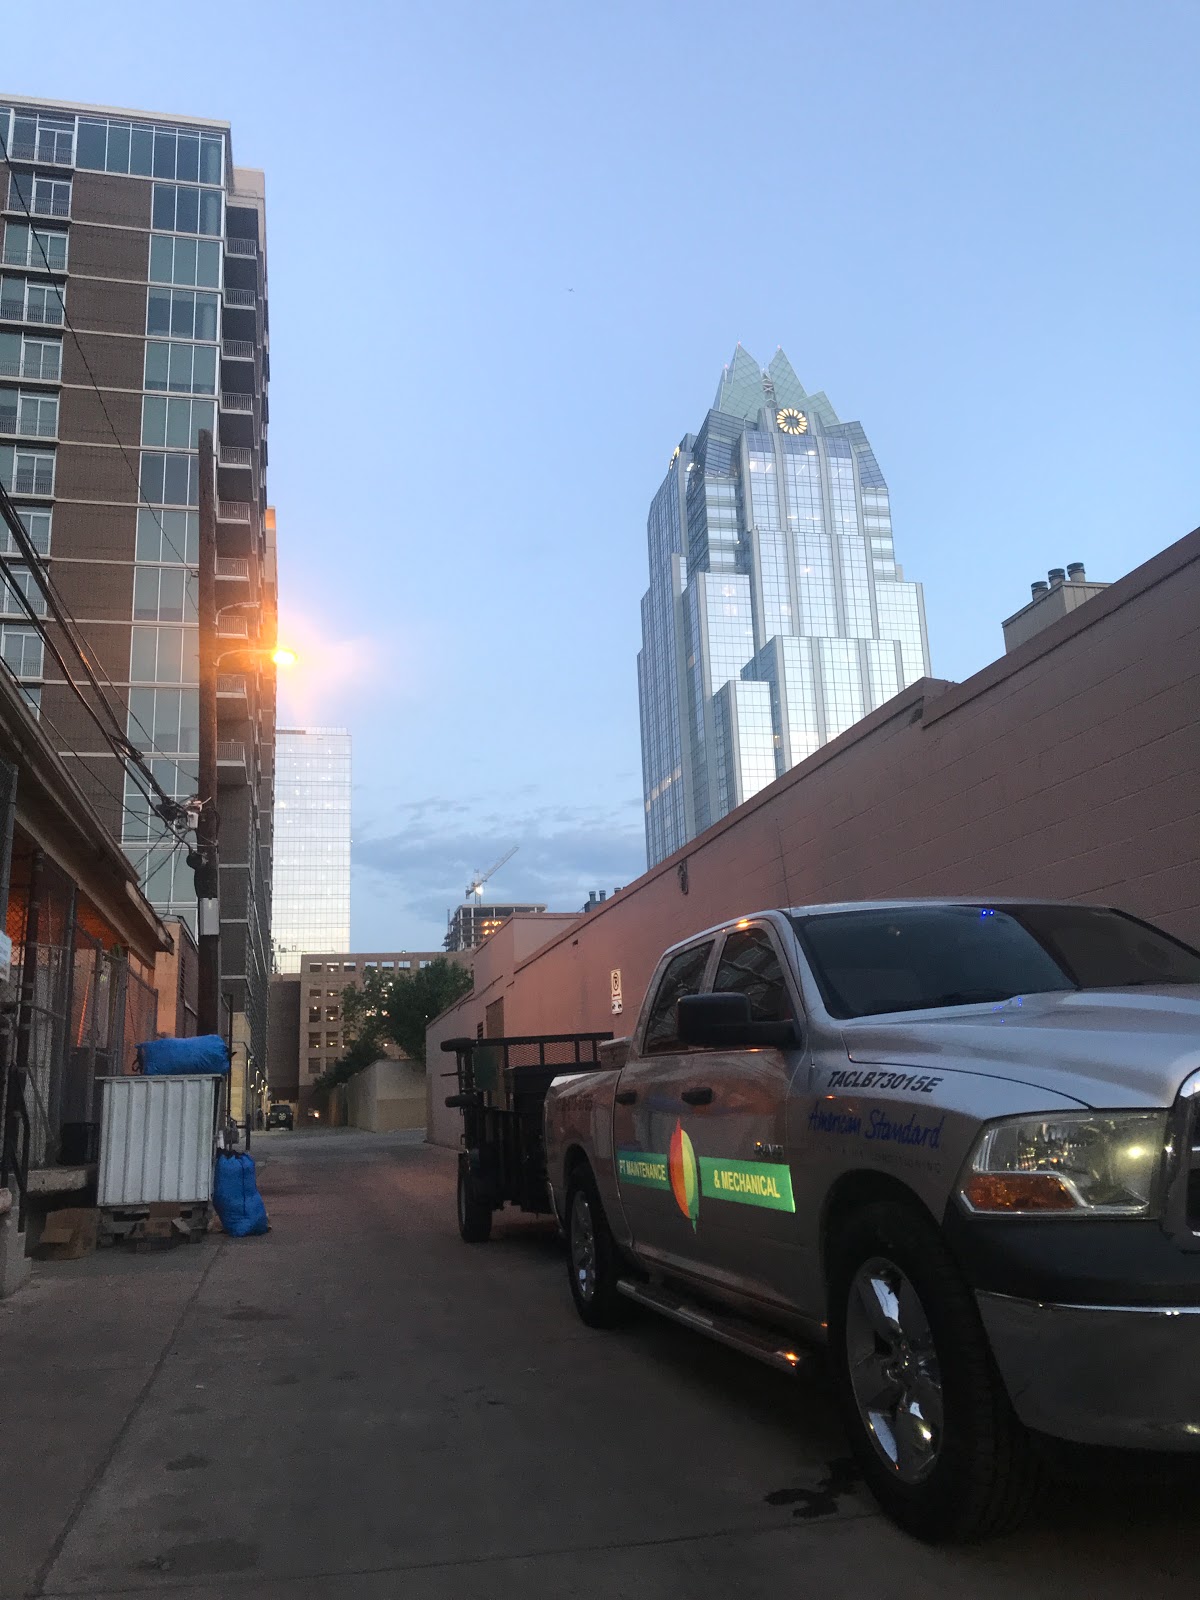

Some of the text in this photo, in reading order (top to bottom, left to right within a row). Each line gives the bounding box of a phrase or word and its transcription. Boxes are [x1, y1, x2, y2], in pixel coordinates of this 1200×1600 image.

[827, 1071, 944, 1093] TACLB73015E
[865, 1108, 946, 1149] Standard
[626, 1160, 667, 1181] MAINTENANCE
[713, 1169, 721, 1189] &
[721, 1170, 781, 1199] MECHANICAL
